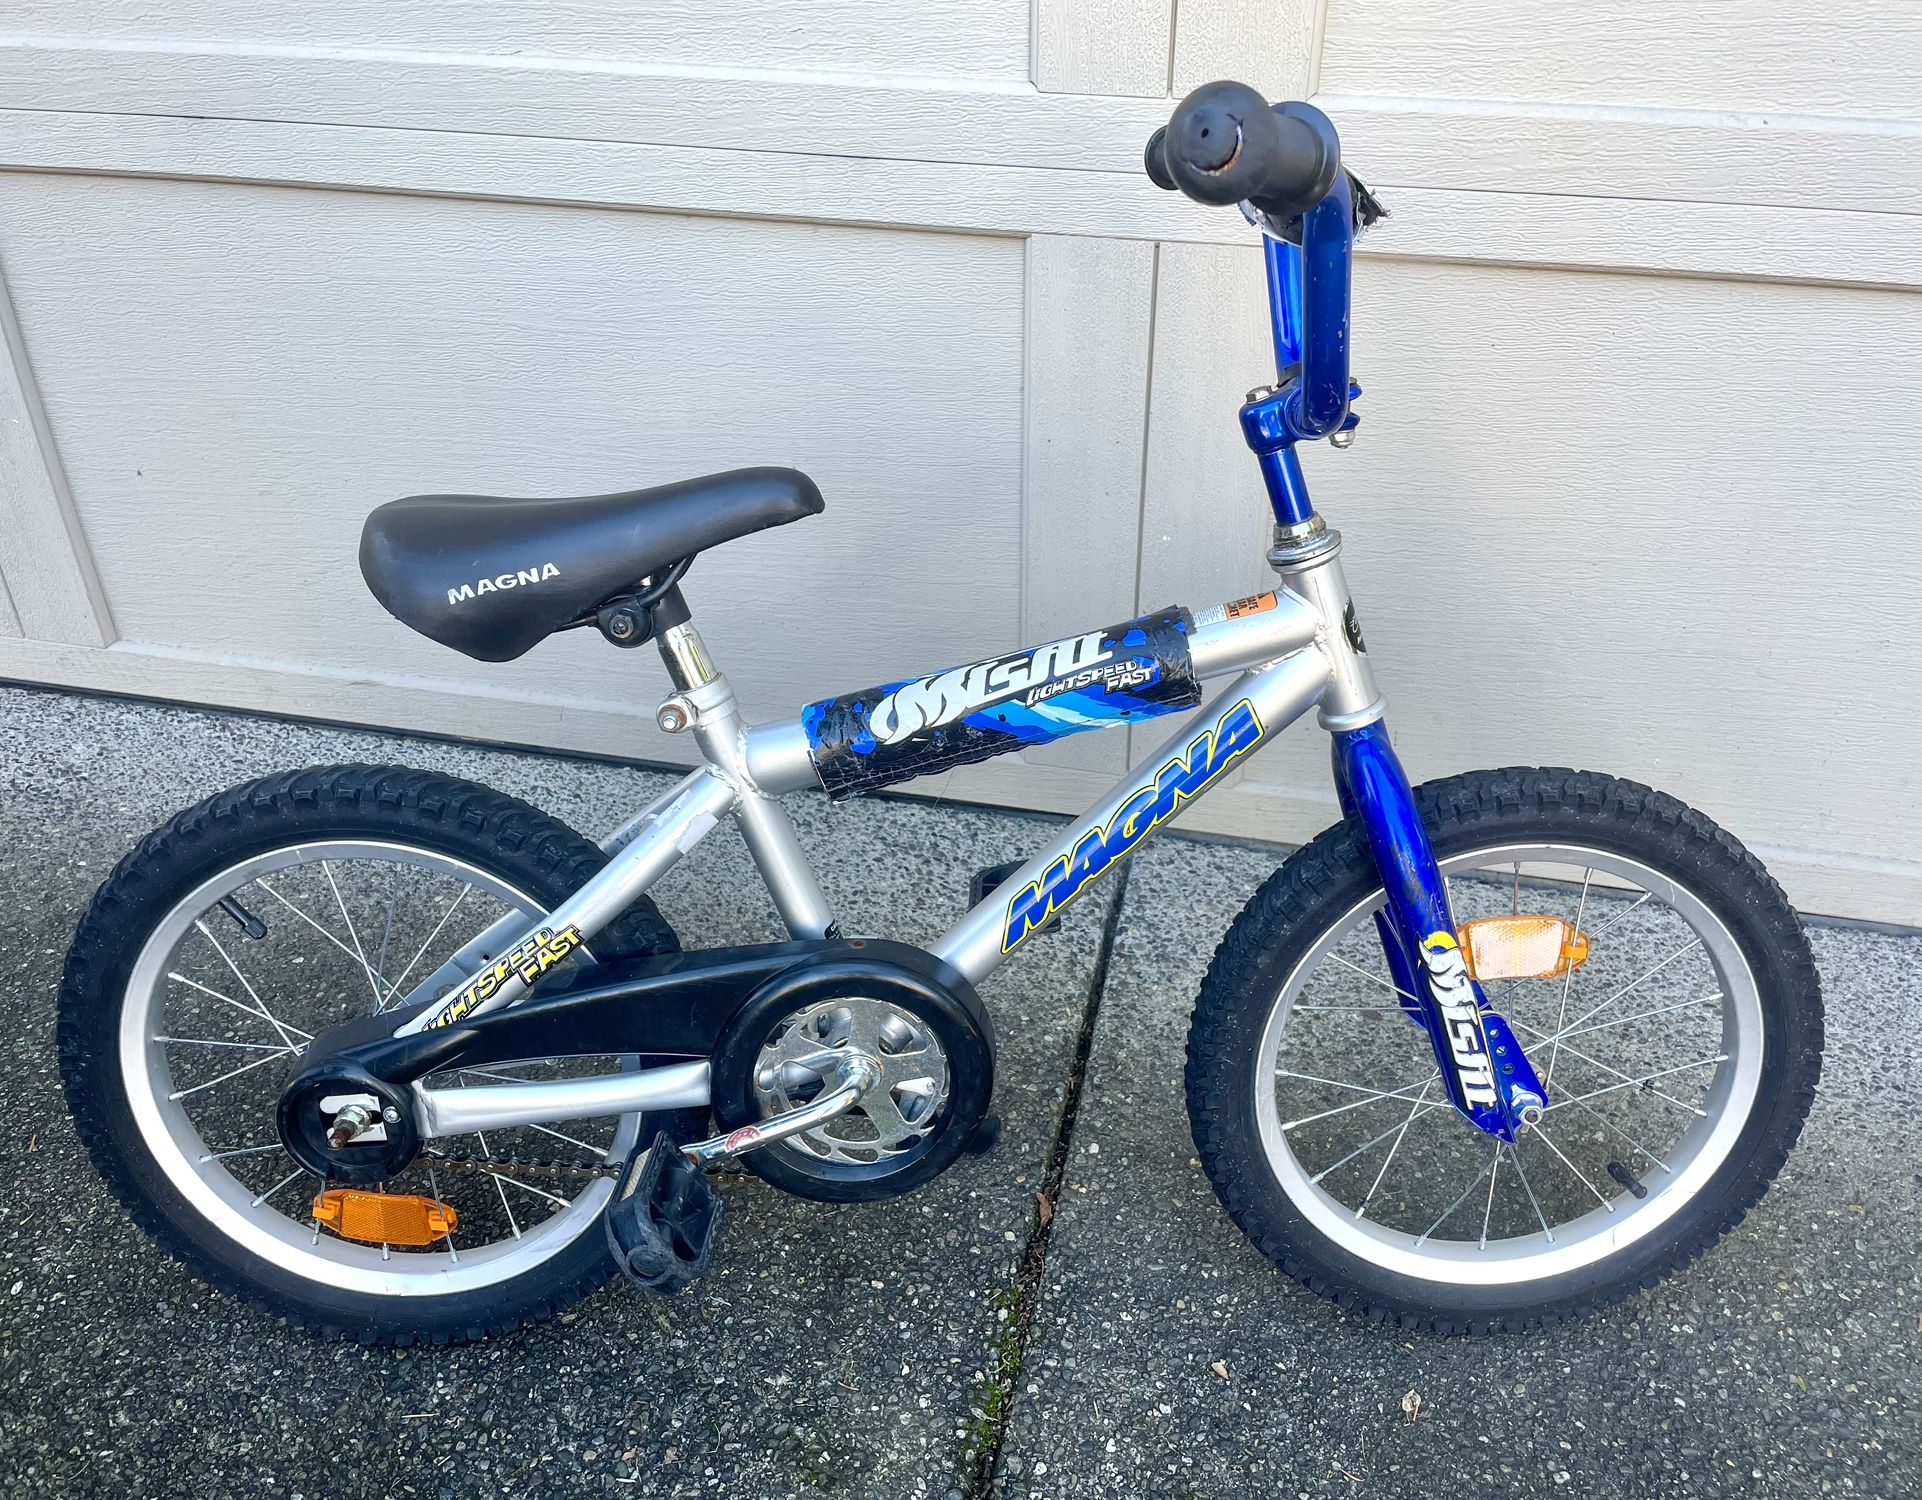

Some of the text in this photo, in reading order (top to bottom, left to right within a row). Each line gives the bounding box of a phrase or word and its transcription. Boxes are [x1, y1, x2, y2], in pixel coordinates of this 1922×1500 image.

[447, 562, 560, 605] MAGNA
[1106, 667, 1153, 694] FAST
[1000, 698, 1265, 955] MAGNA
[422, 926, 556, 1032] IGHTSPEED
[517, 924, 585, 987] FAST
